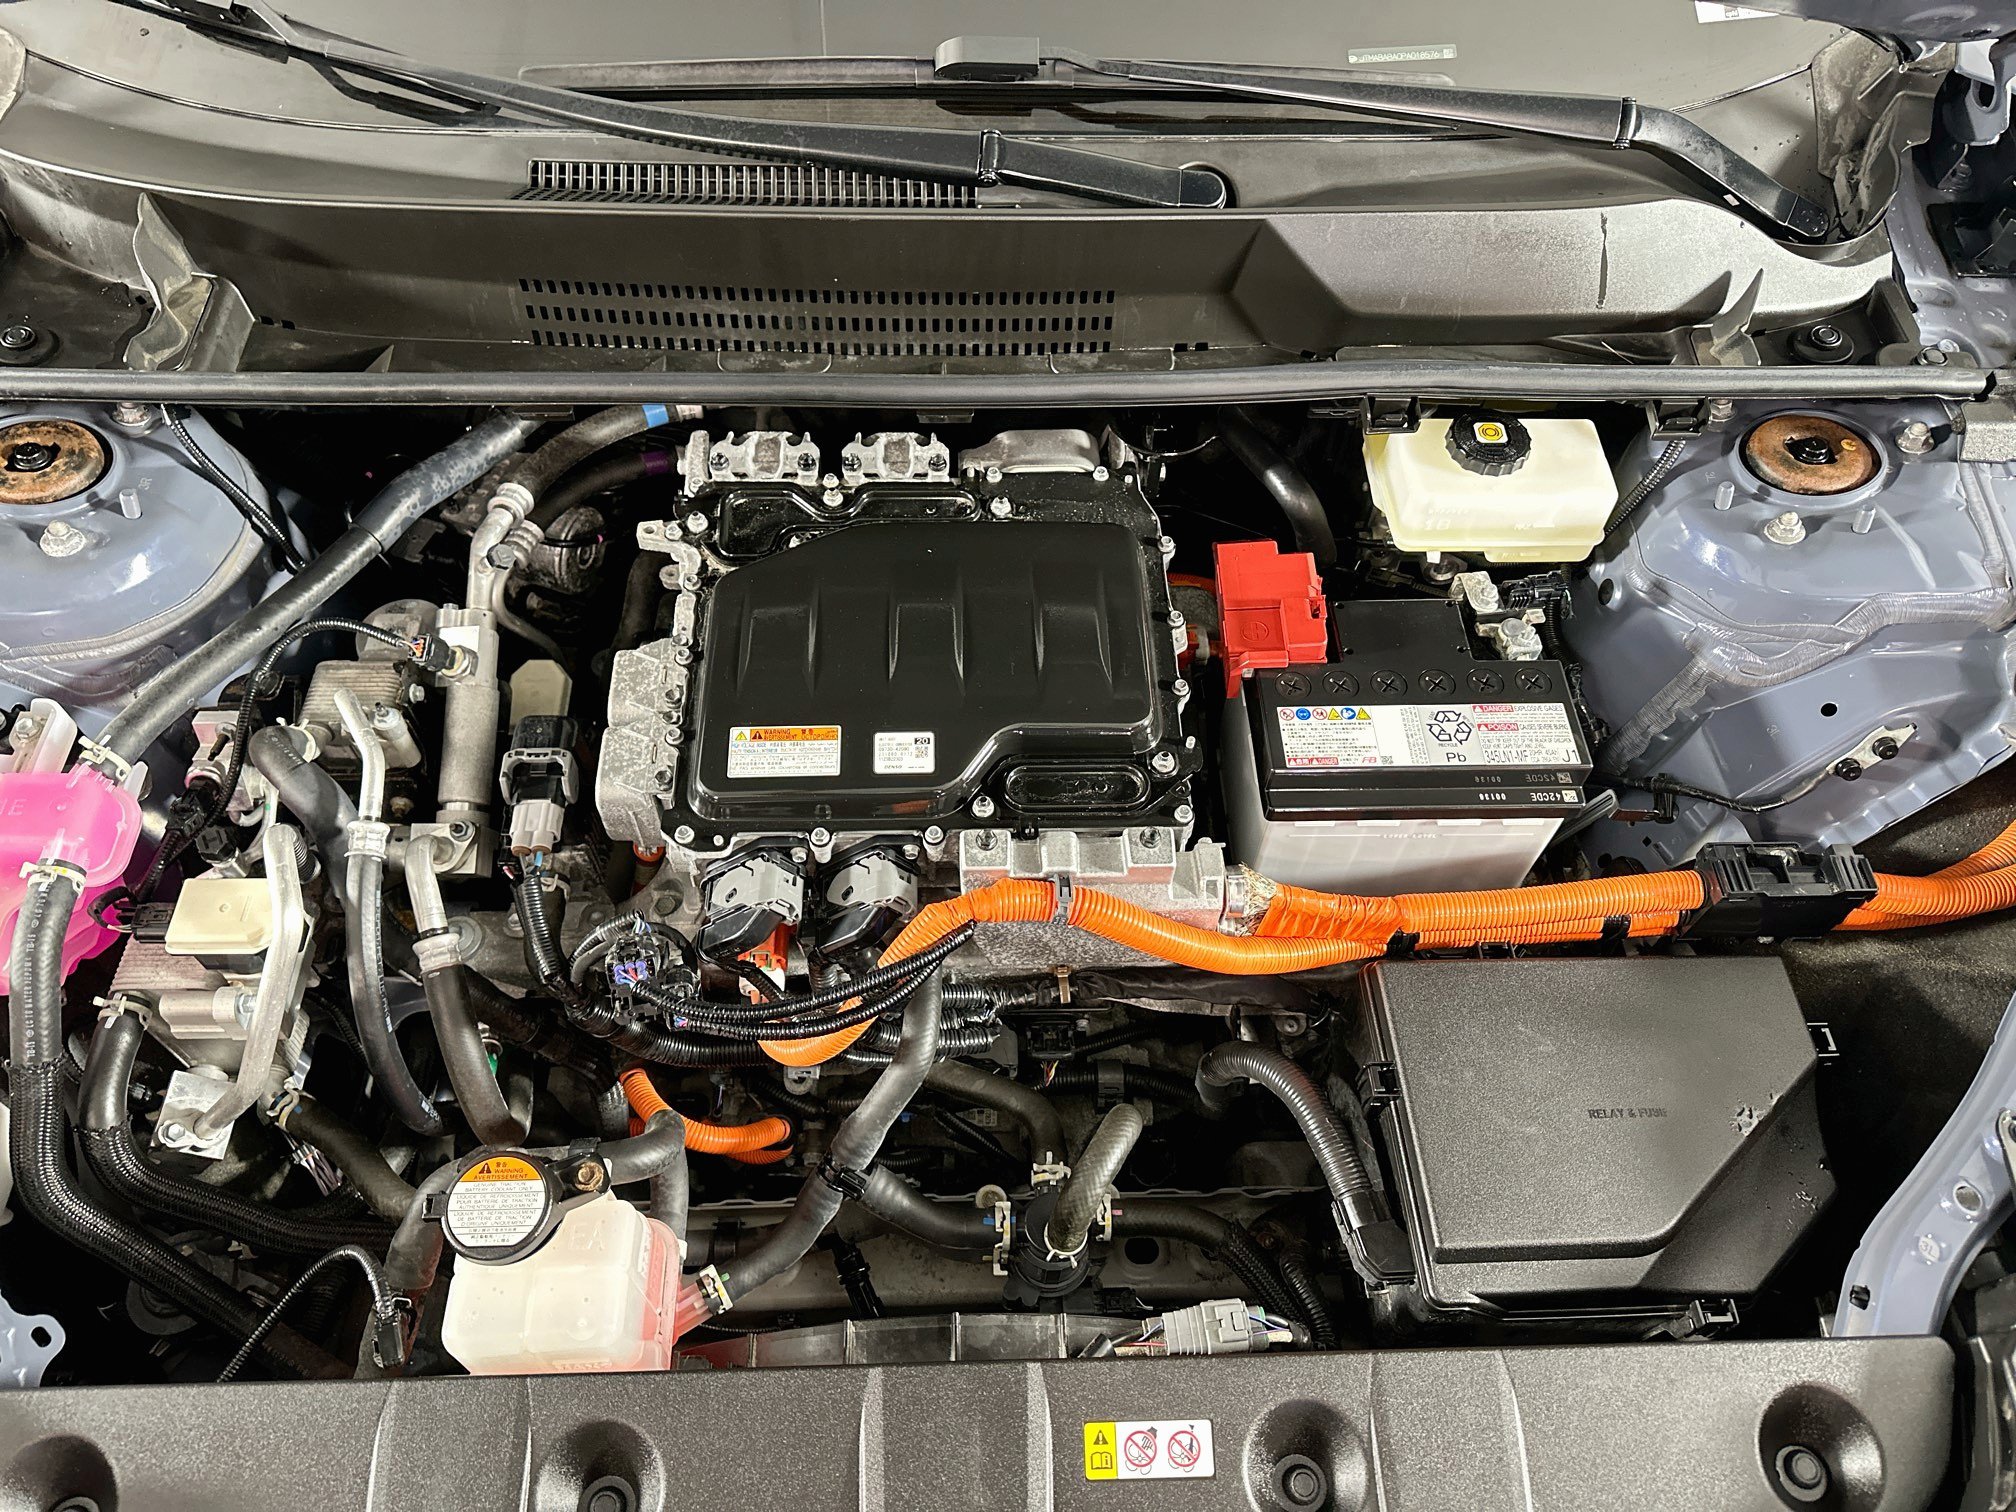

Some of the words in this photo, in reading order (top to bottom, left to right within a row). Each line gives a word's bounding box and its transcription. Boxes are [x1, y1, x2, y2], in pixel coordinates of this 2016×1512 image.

[1446, 752, 1467, 763] Pb
[1529, 792, 1561, 802] 42CDE
[23, 986, 34, 1008] WATER
[1588, 1109, 1624, 1119] RELAY
[1627, 1108, 1637, 1118] &
[1638, 1108, 1668, 1118] FUSE
